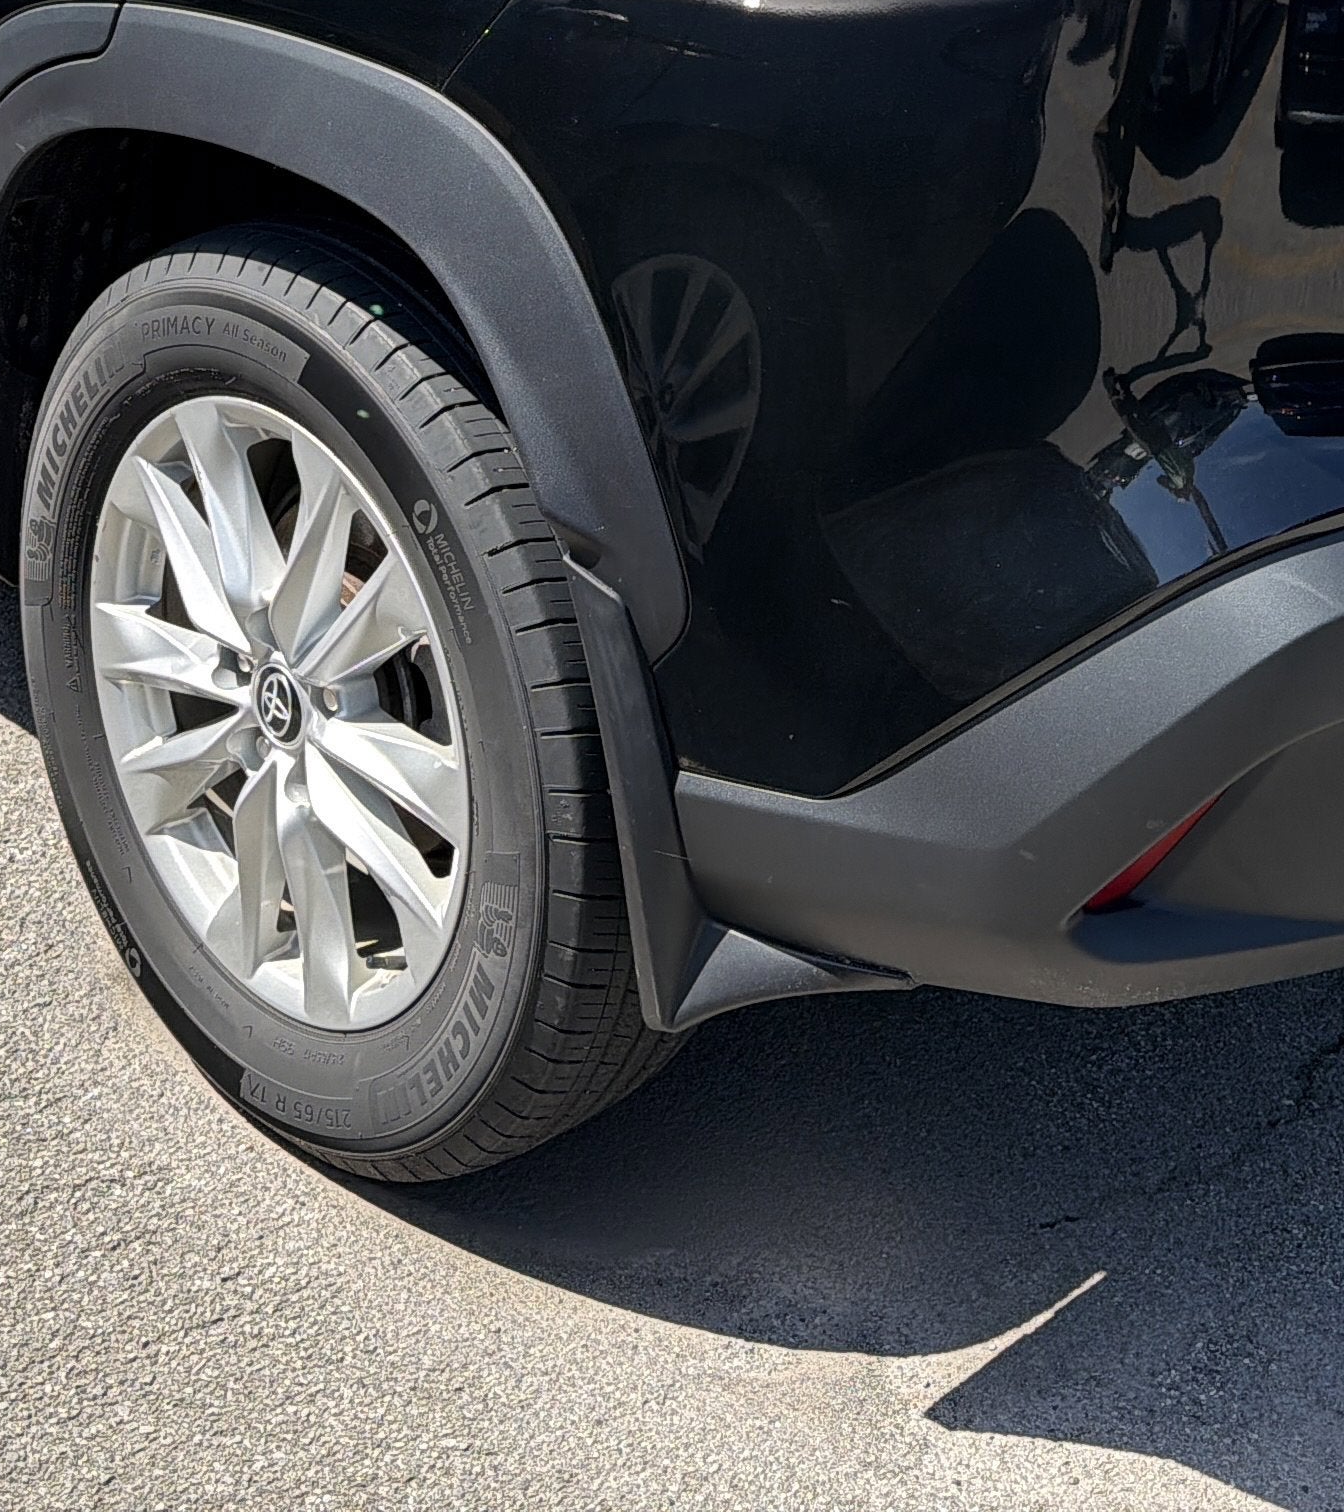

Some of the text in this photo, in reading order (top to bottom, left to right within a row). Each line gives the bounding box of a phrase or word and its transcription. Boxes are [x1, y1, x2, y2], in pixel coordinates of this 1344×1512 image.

[141, 316, 288, 363] PRIMACY All Season
[36, 341, 126, 512] MICHELIN
[434, 533, 475, 611] MICHELIN
[374, 961, 496, 1126] MICHELIN
[275, 1095, 287, 1113] R
[293, 1103, 352, 1130] 215/65
